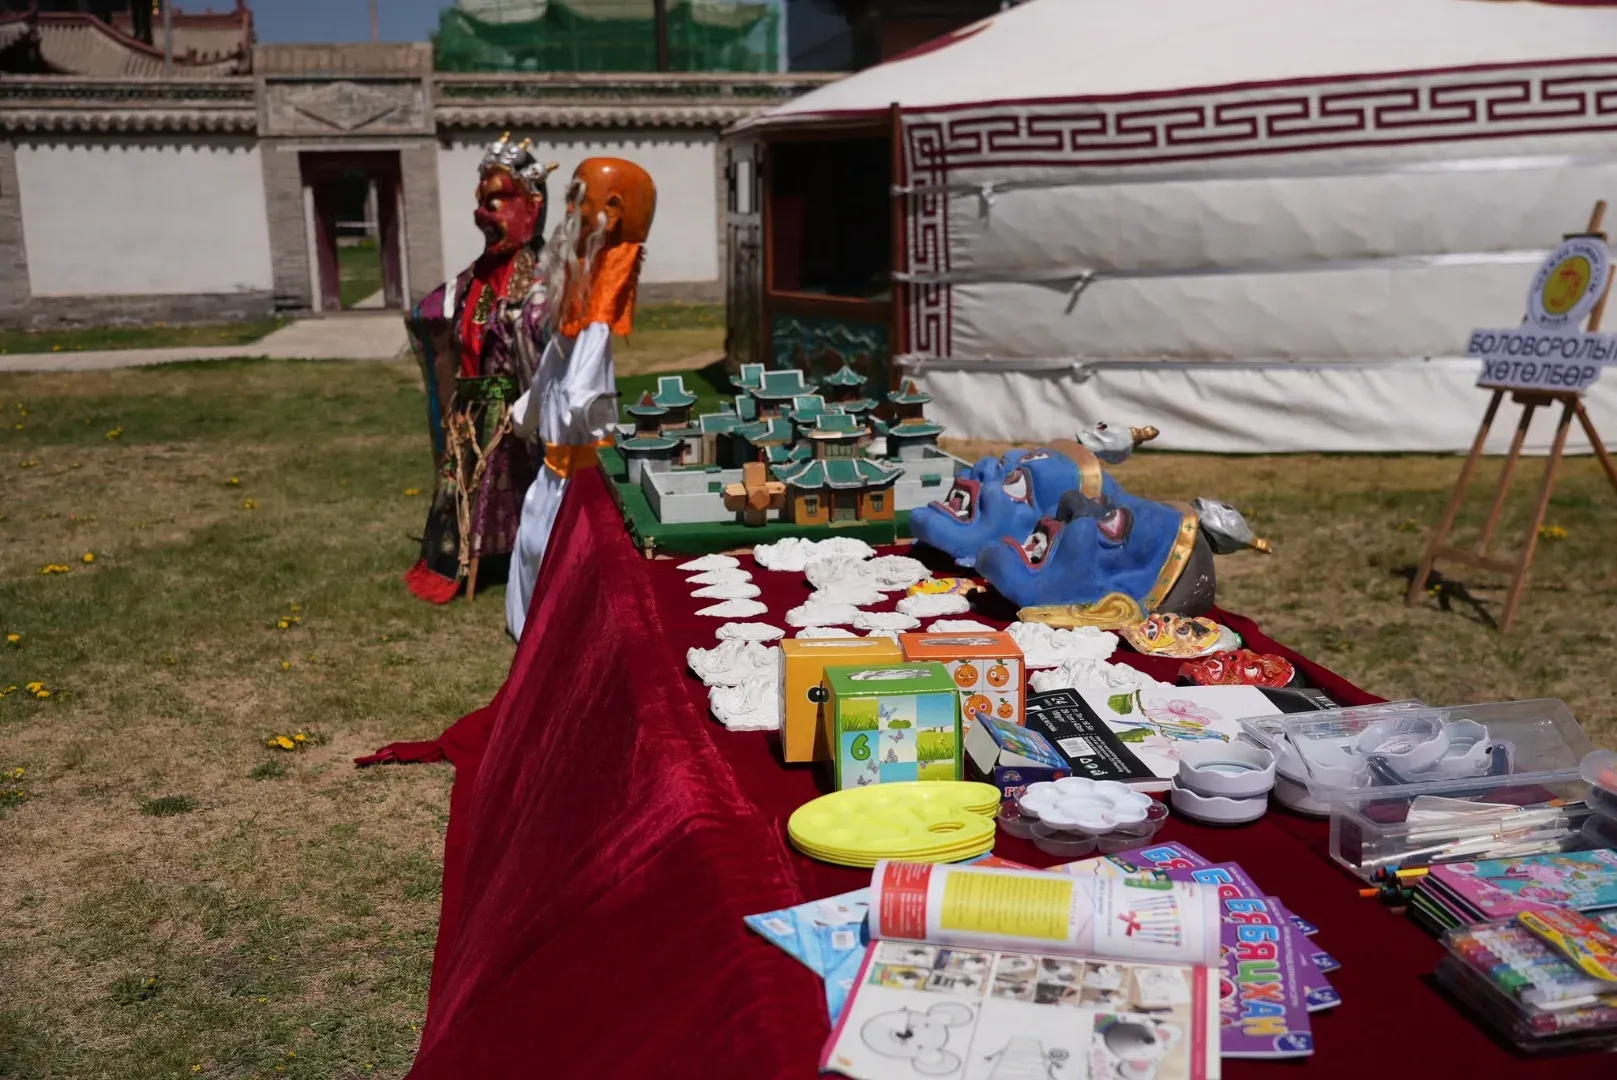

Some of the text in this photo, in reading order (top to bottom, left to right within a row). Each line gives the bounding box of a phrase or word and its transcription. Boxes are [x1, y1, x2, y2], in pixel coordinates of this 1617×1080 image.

[1468, 334, 1617, 361] БОЛОВСРОЛЫ
[1481, 360, 1596, 387] ХӨТӨЛБӨР
[1051, 696, 1068, 704] 24
[851, 733, 871, 761] 6
[1234, 924, 1289, 1036] БЯЦХАН
